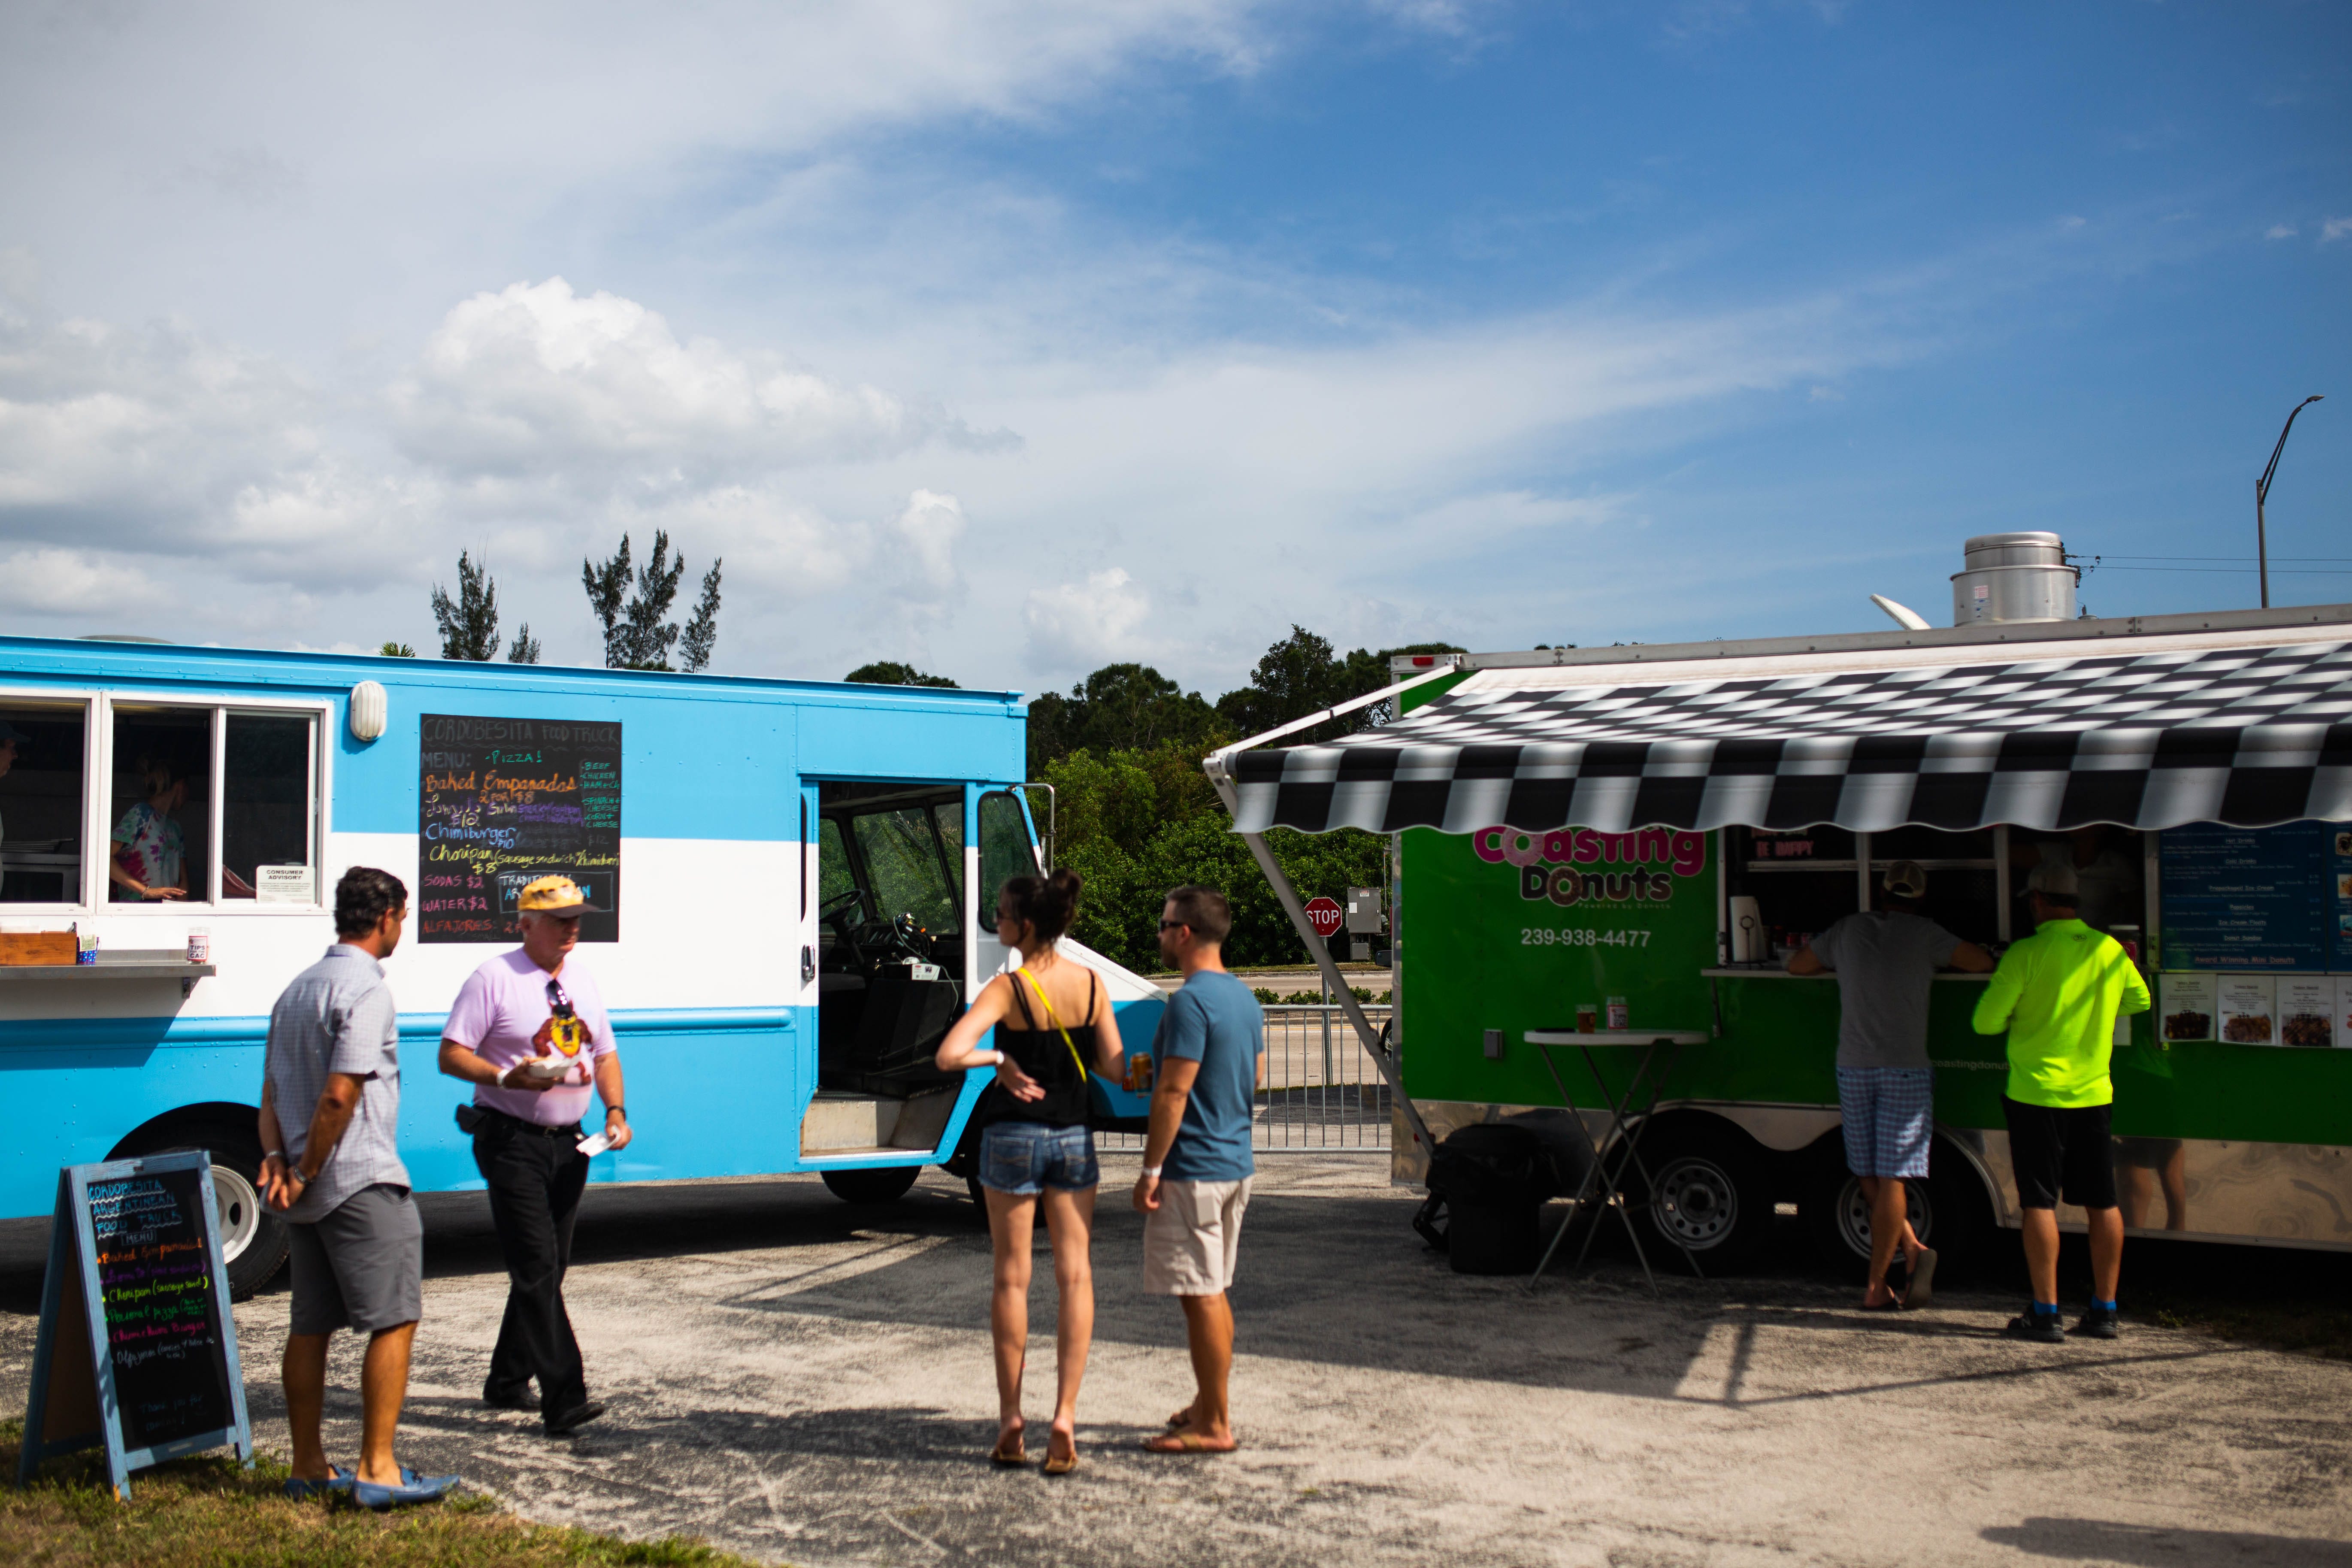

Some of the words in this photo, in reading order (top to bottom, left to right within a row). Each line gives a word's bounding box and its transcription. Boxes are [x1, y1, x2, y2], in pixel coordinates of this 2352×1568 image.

[426, 770, 477, 793] Baked
[430, 844, 494, 865] Choripan
[423, 874, 463, 887] SODAS
[466, 875, 484, 889] $2
[1519, 865, 1673, 907] Donuts
[422, 898, 466, 912] WATER
[467, 894, 488, 911] $2
[1306, 910, 1339, 924] STOP
[1520, 928, 1652, 947] 239-938-4477
[88, 1179, 163, 1200] CORDOBESITA
[95, 1219, 128, 1233] FOOD
